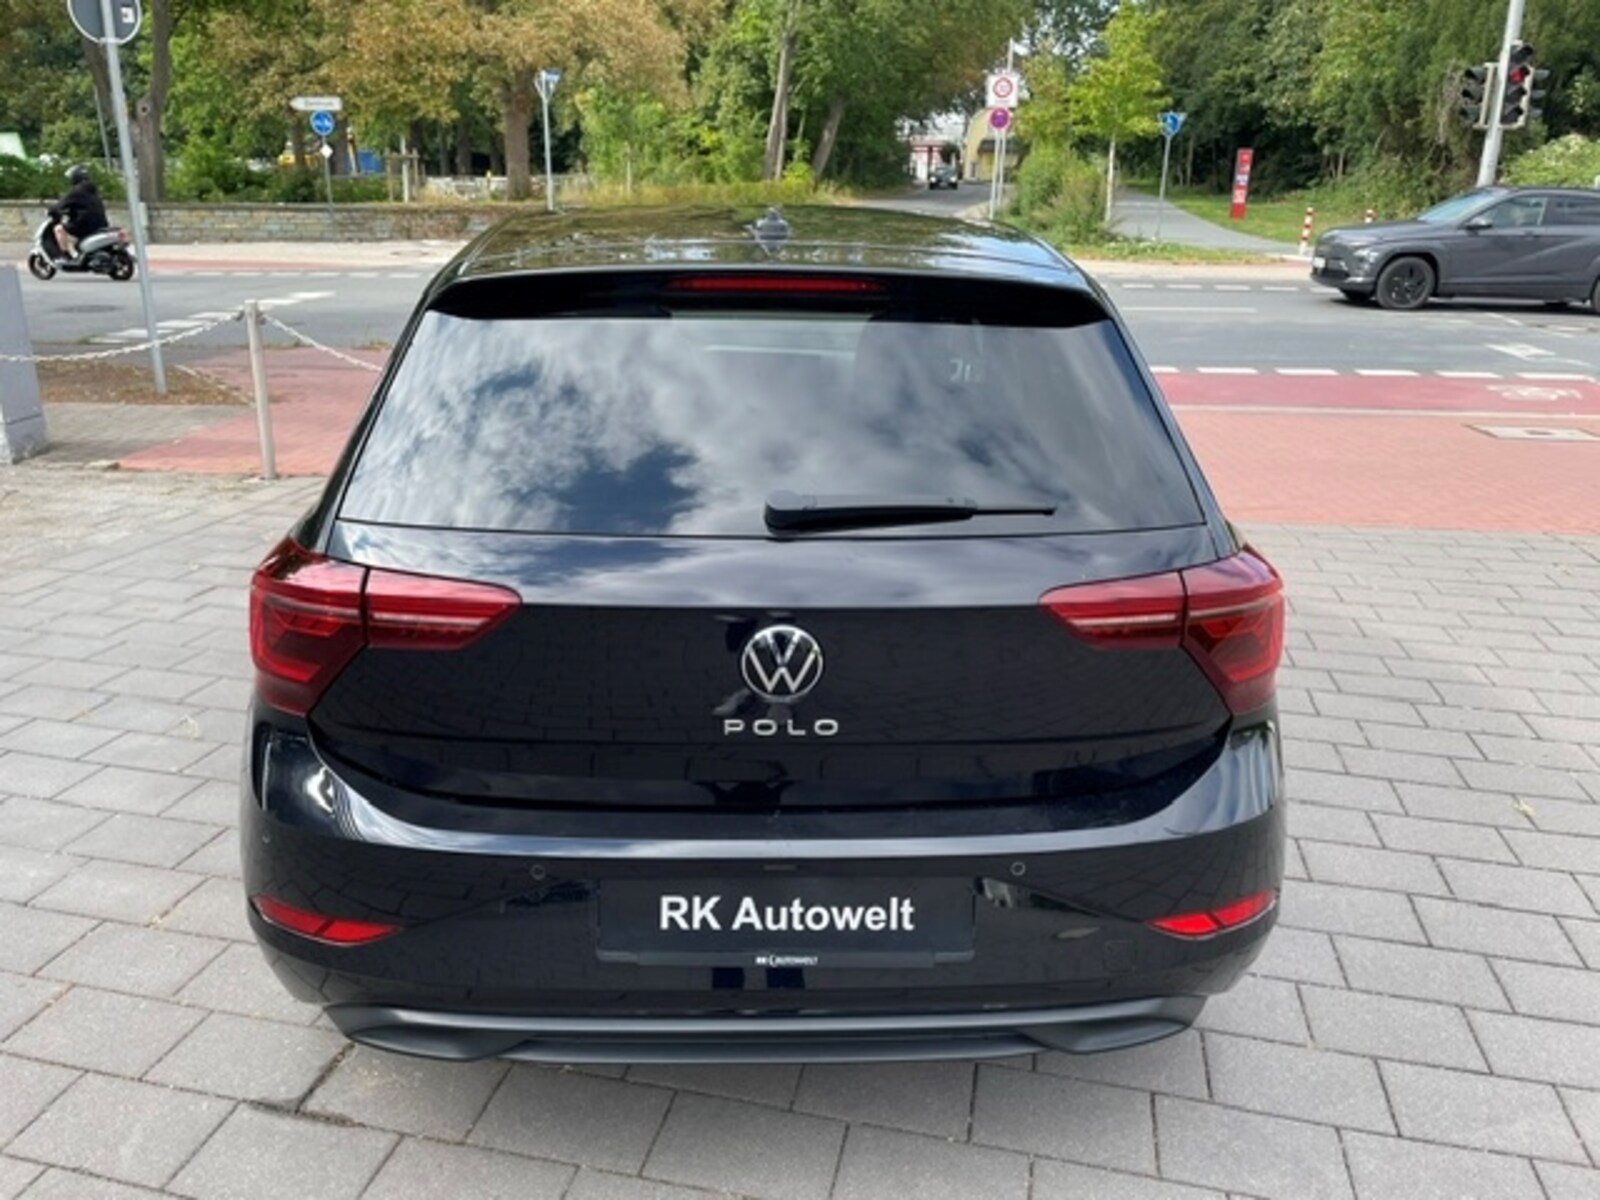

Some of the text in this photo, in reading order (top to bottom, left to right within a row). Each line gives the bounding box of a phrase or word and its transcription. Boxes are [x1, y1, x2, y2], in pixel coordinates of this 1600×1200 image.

[724, 718, 839, 736] POLO
[660, 895, 915, 931] RK Autowelt
